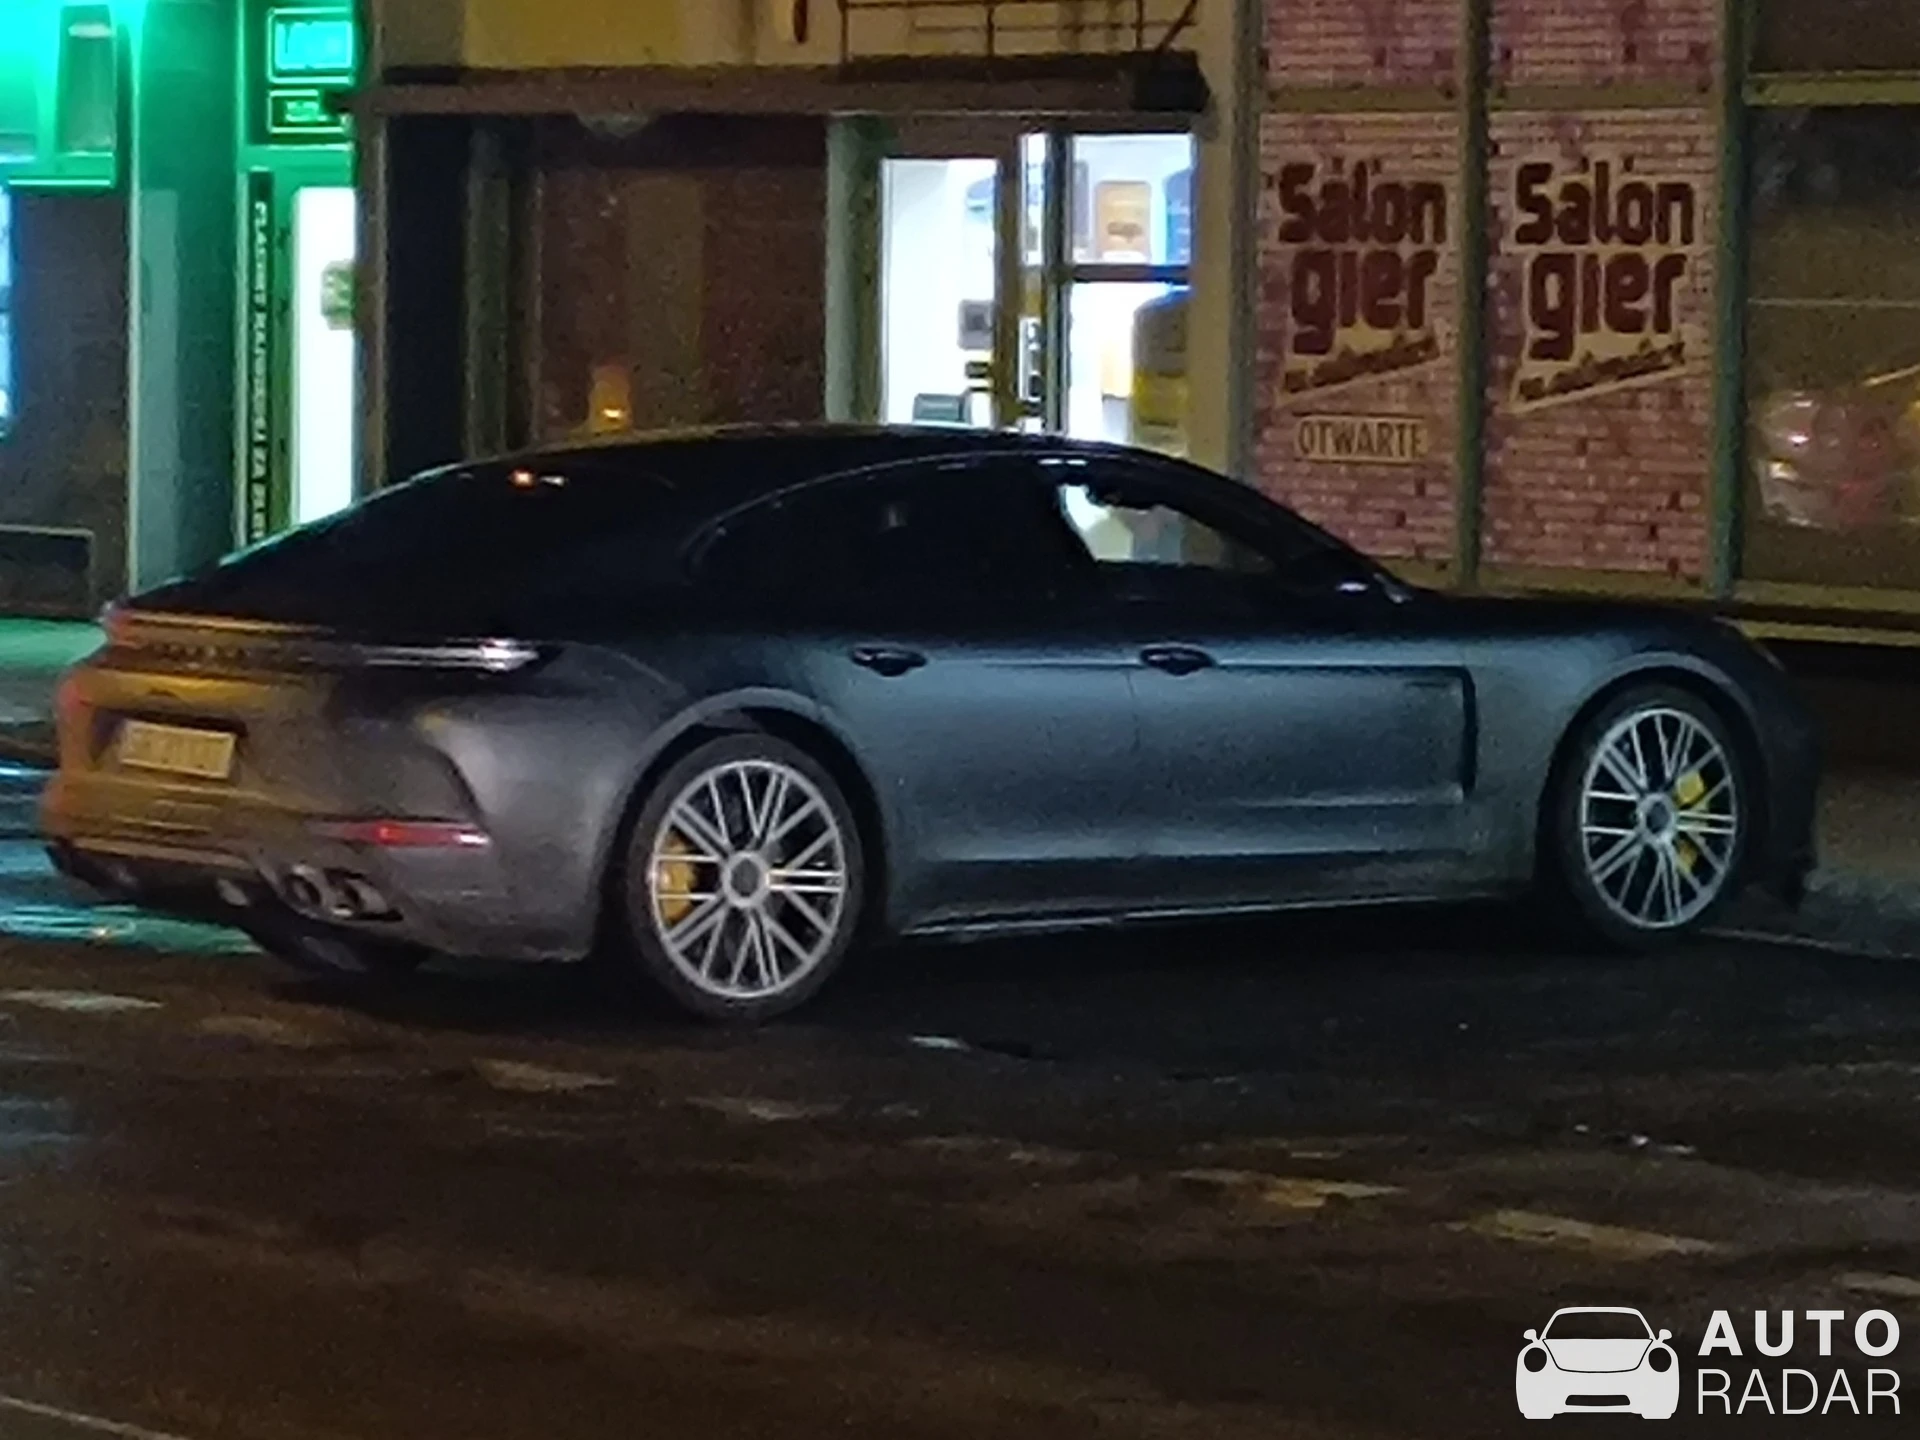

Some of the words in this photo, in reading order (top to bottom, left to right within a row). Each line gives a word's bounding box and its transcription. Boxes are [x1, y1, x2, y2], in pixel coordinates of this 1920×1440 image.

[1279, 159, 1446, 244] Salon
[1515, 161, 1693, 246] Salon
[1292, 251, 1438, 355] gier
[1529, 253, 1687, 360] gier
[1299, 420, 1427, 459] OTWARTE
